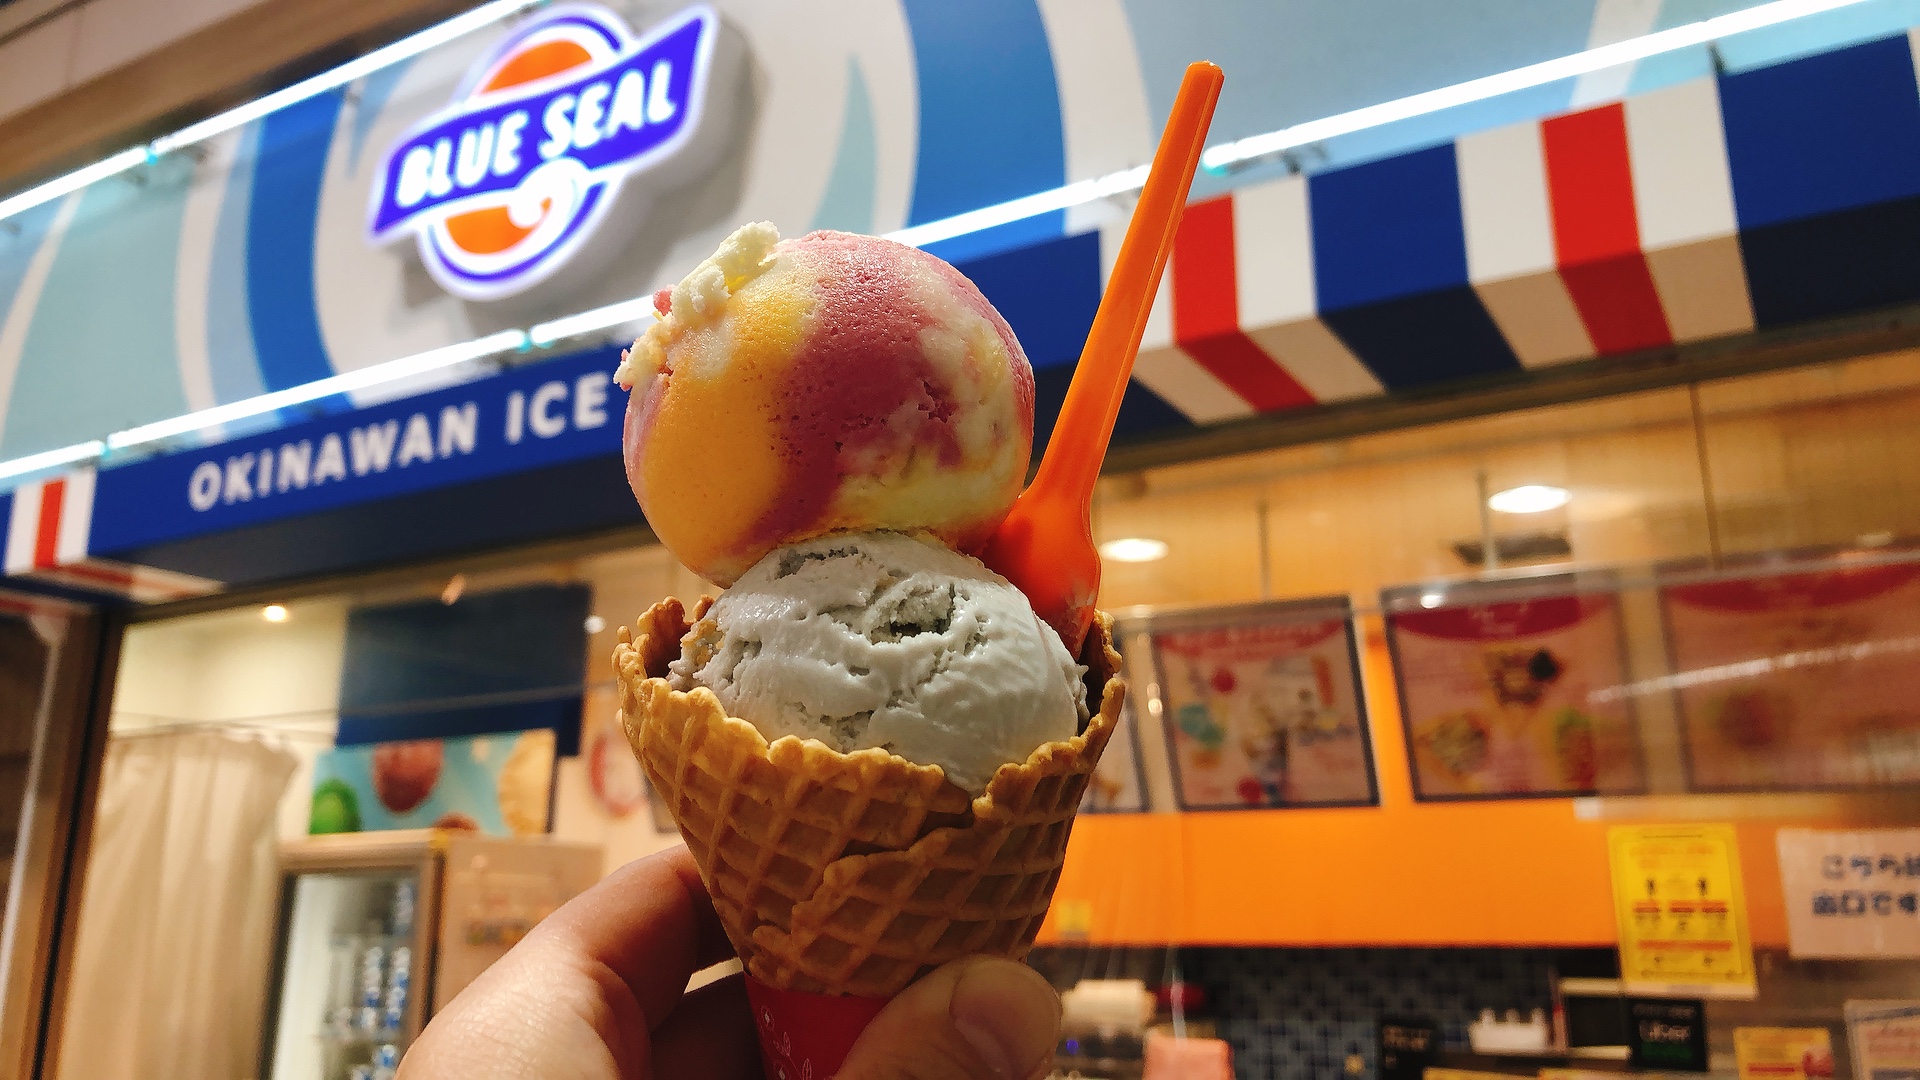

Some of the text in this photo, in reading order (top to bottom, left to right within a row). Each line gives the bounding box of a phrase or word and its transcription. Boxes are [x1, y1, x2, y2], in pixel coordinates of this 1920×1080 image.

[396, 60, 677, 208] BLUE SEAL
[188, 372, 609, 512] OKINAWAN ICE
